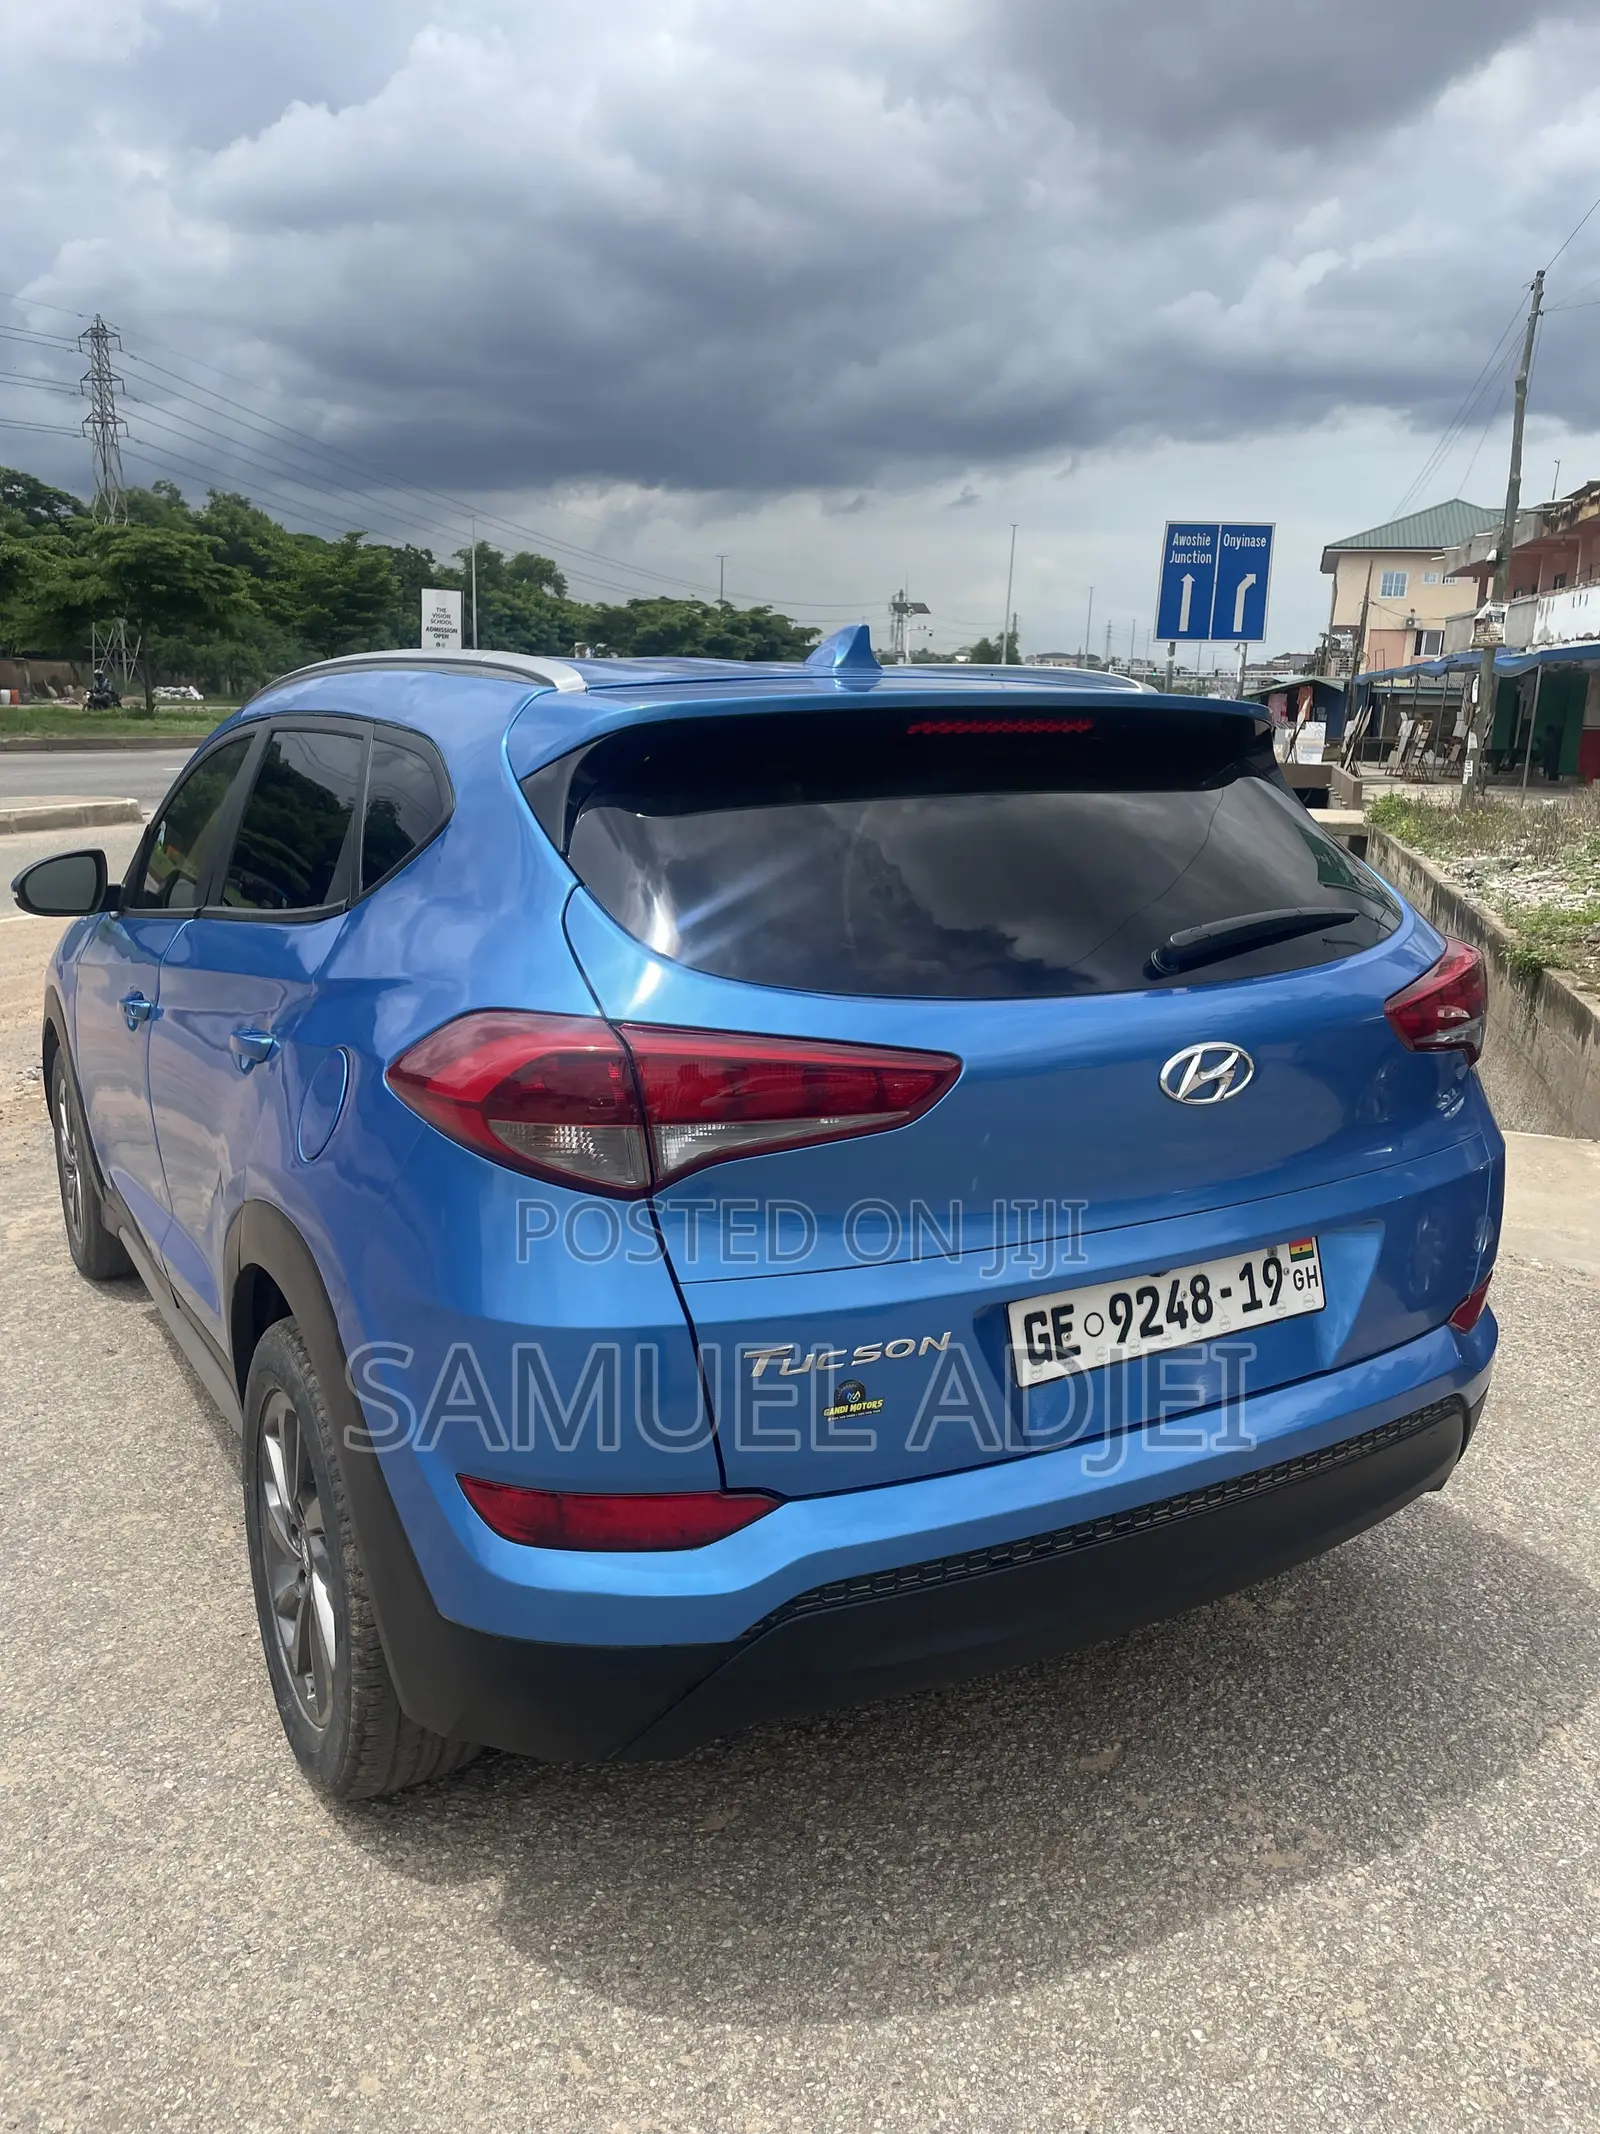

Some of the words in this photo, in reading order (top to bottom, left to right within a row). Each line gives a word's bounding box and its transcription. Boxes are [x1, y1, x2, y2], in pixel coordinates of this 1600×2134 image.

[1172, 533, 1211, 546] Awoshie
[1223, 533, 1267, 550] Onyinase
[1169, 550, 1212, 564] Junction
[426, 626, 458, 634] ADMISSION
[1292, 1265, 1319, 1291] GH
[1024, 1303, 1082, 1366] GE
[744, 1331, 952, 1378] TUCSON
[823, 1405, 849, 1417] GANDI
[849, 1399, 884, 1413] MOTORS
